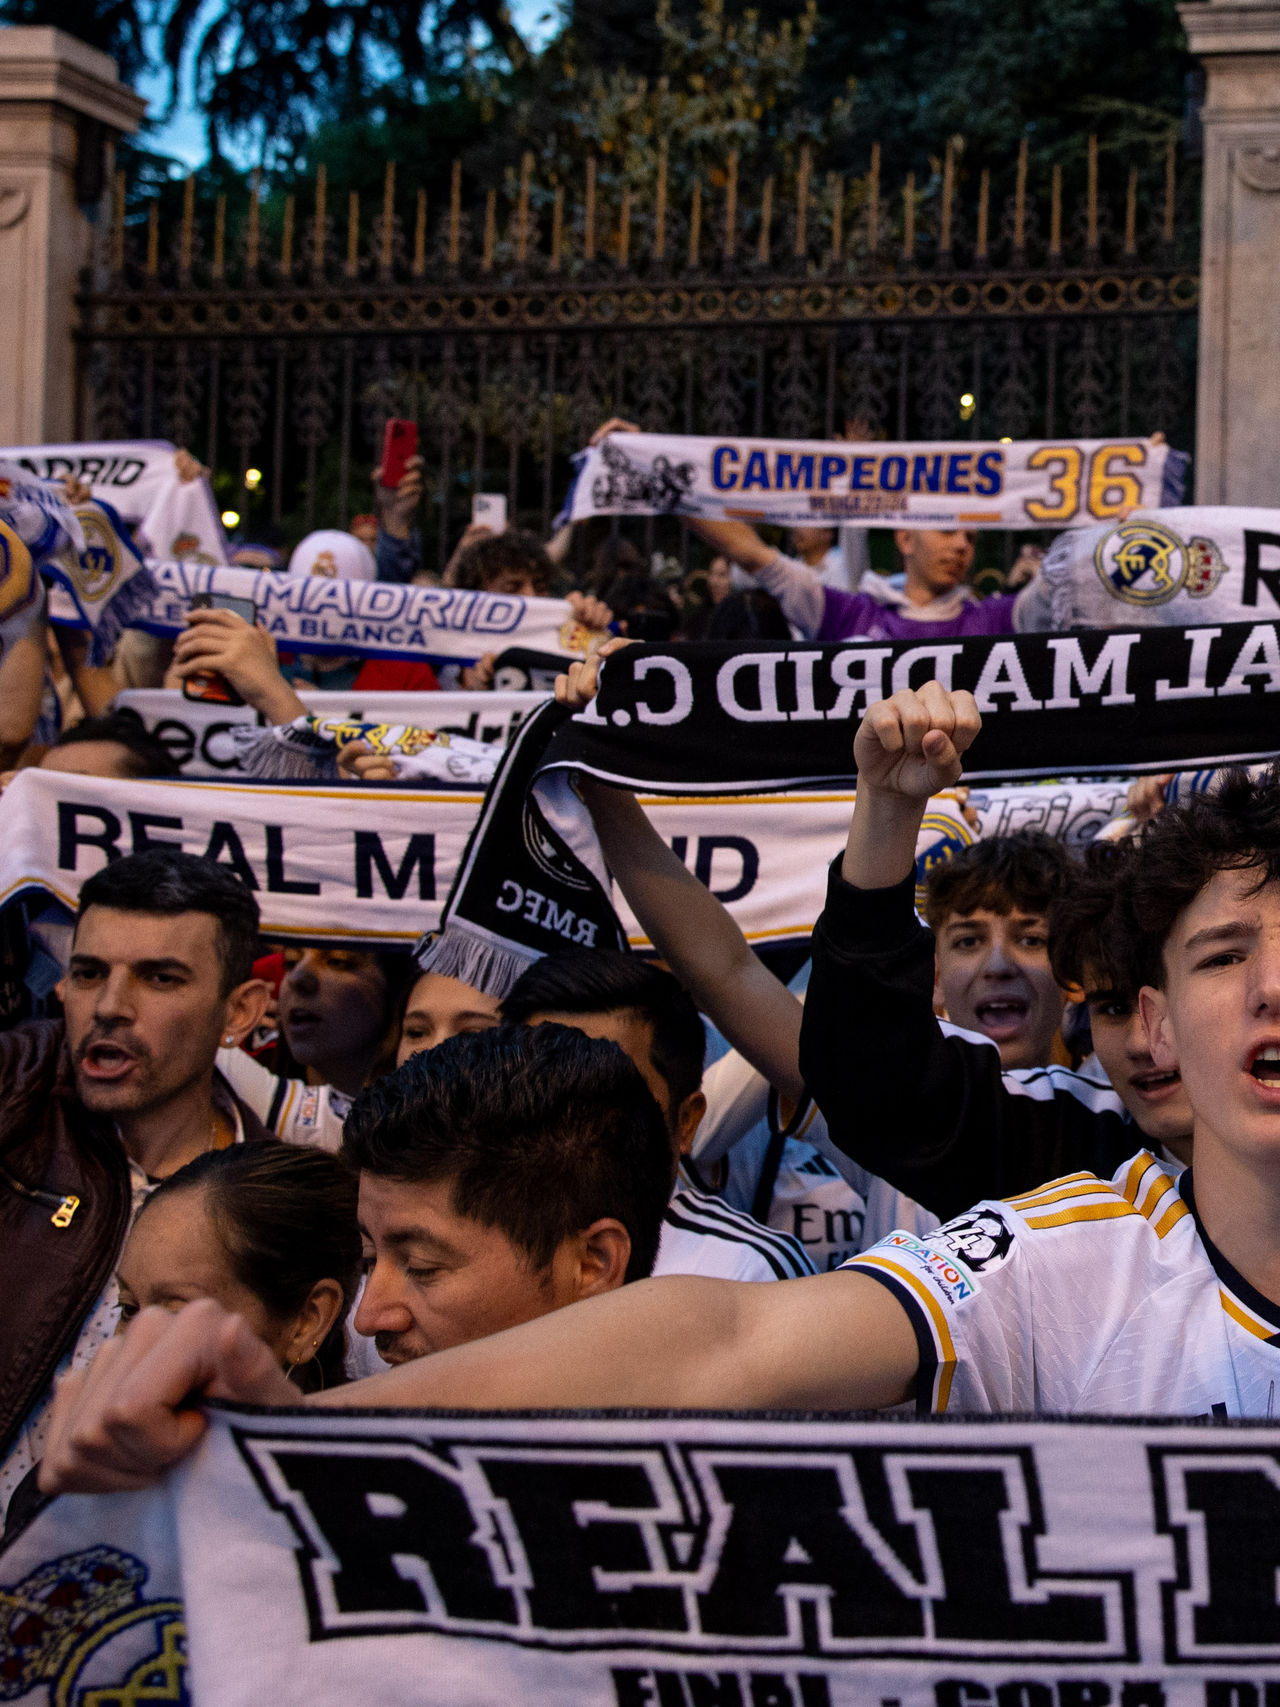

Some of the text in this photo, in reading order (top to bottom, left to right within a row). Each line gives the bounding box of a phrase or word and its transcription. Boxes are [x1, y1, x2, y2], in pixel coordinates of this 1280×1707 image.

[711, 443, 1147, 523] CAMPEONES 36
[253, 575, 528, 635] MADRID
[301, 616, 427, 647] BLANCA
[232, 1432, 1134, 1662] REAL
[609, 1667, 832, 1707] FINAL
